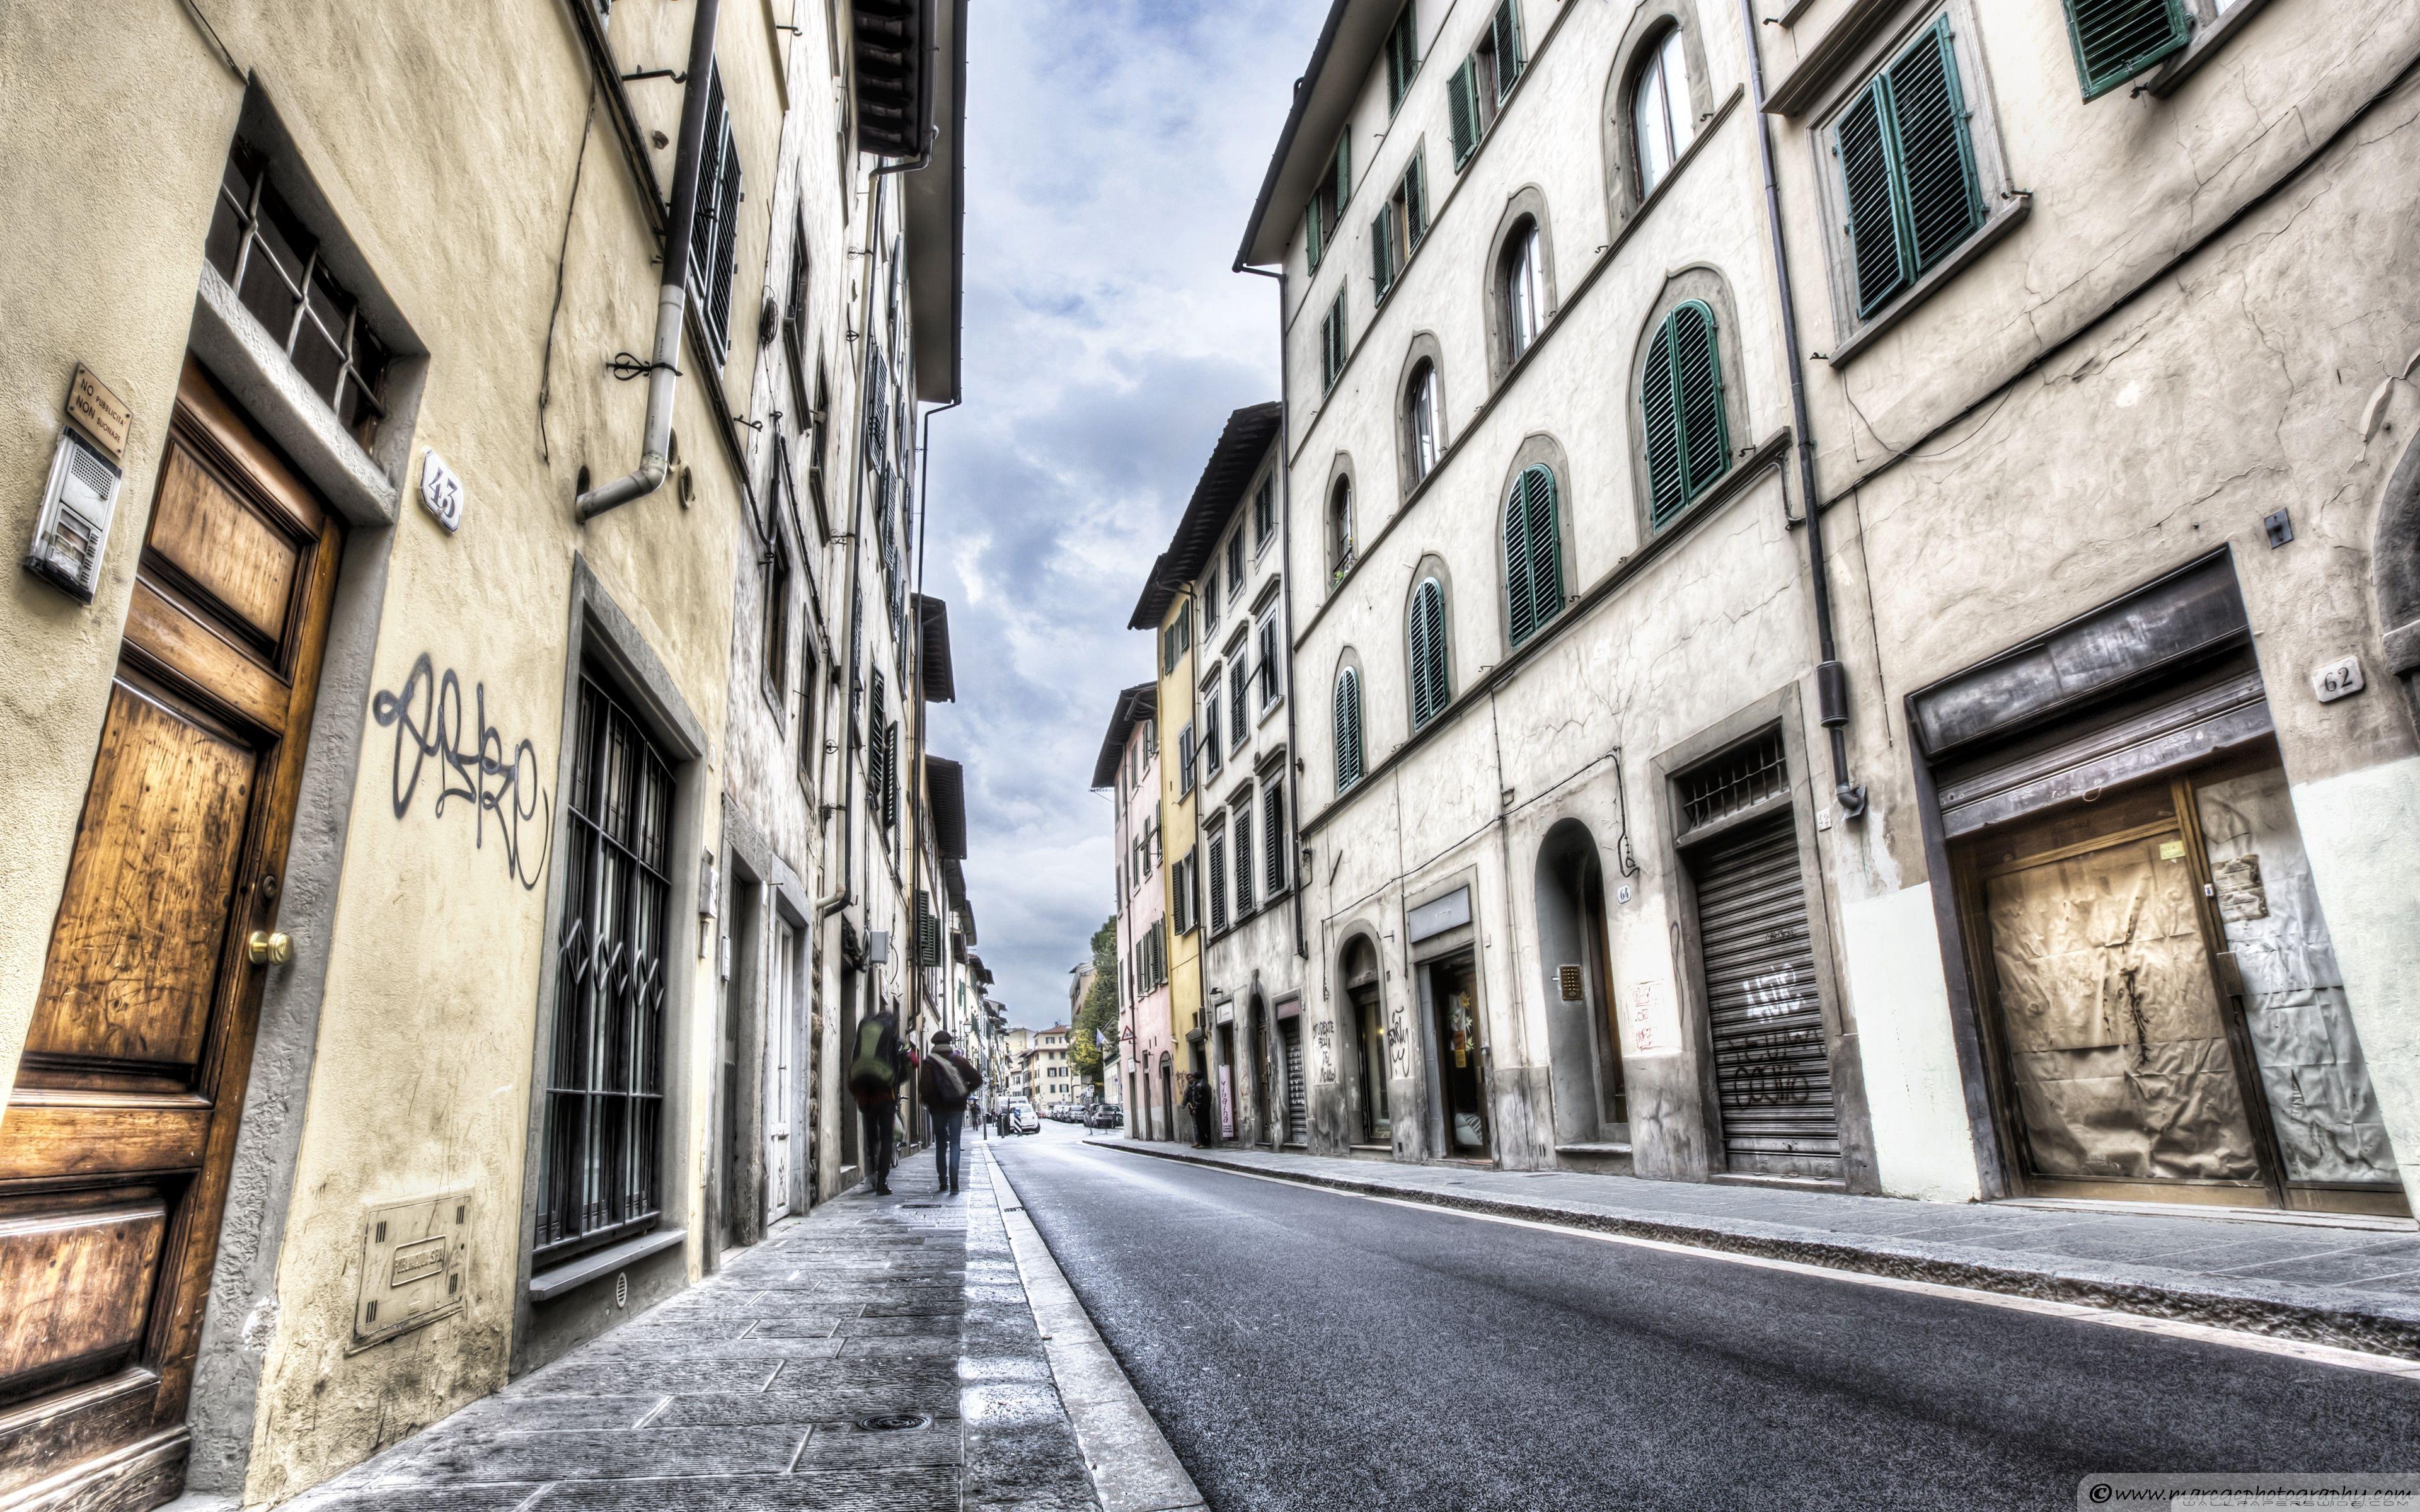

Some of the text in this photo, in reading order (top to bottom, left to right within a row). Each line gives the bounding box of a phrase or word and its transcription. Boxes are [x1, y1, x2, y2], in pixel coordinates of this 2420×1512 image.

[81, 378, 94, 396] NO
[76, 395, 122, 443] NON SUONARE
[2324, 667, 2353, 692] 62
[1620, 887, 1629, 900] 64
